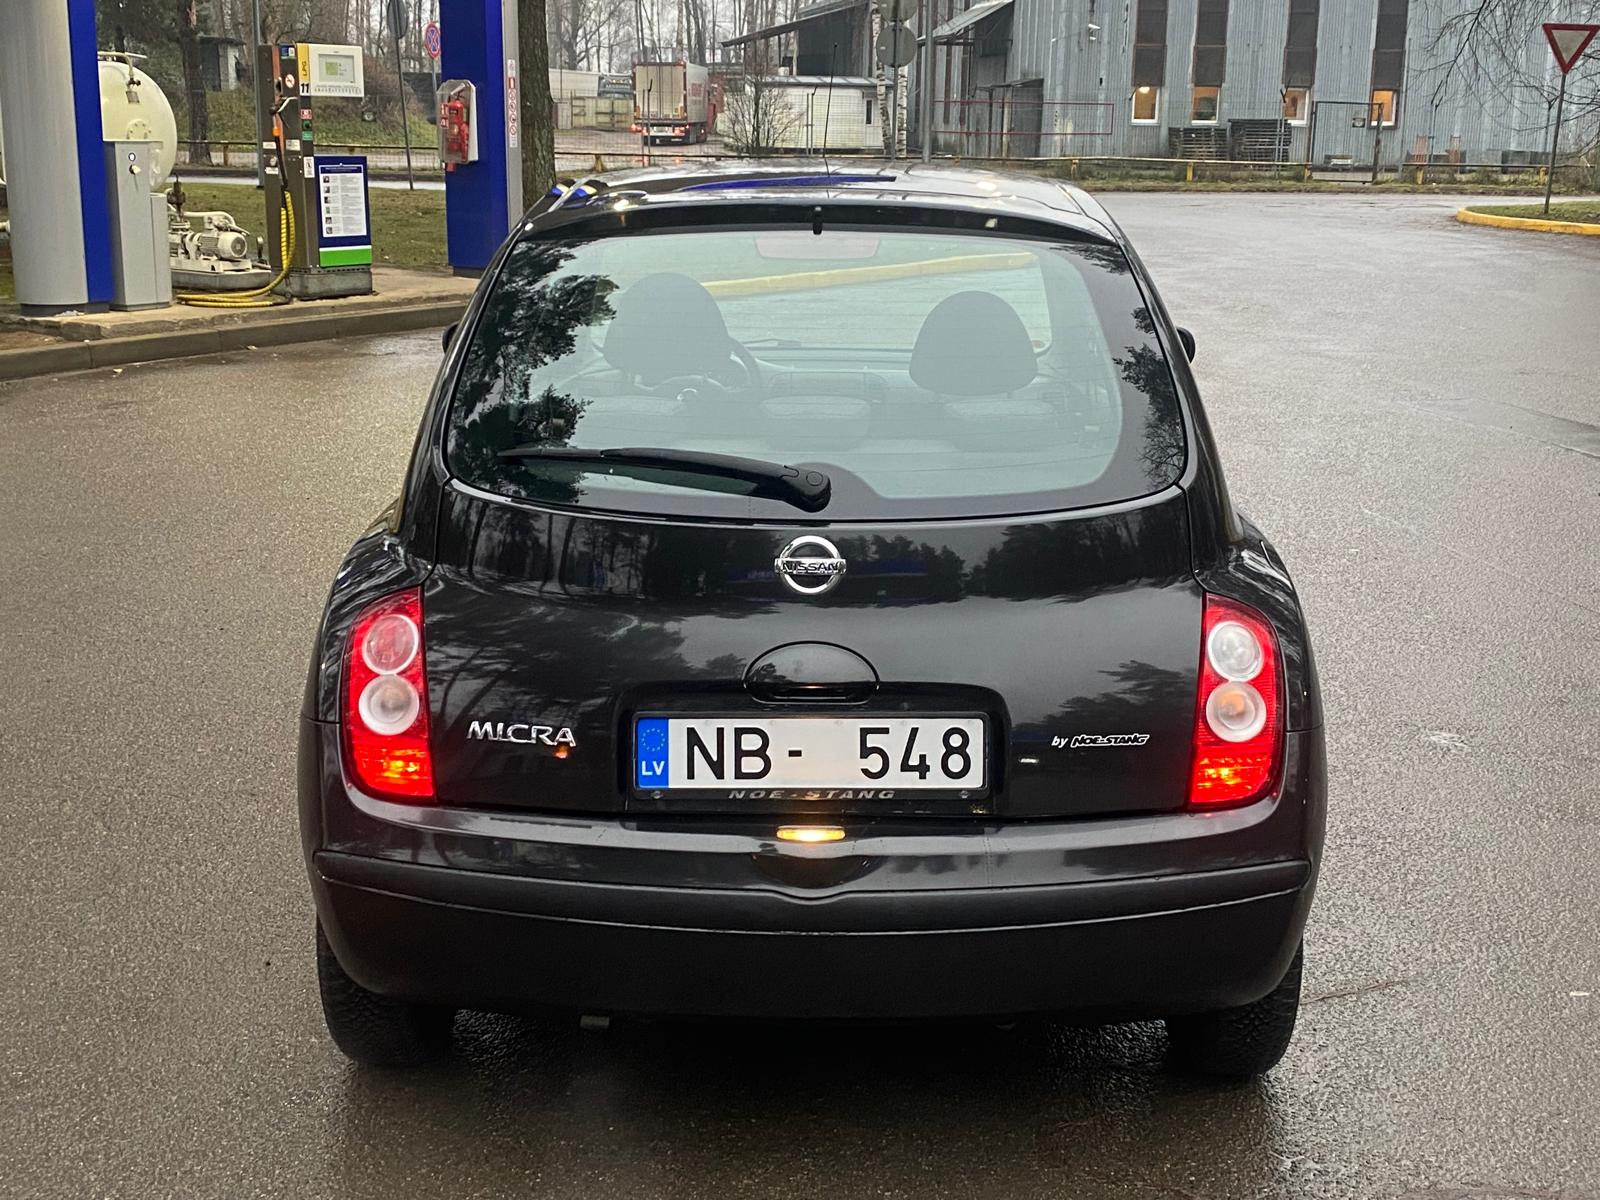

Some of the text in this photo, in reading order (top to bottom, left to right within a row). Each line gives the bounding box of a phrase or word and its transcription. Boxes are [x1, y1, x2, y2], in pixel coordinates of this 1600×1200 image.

[300, 82, 309, 94] 11
[782, 561, 838, 572] NISSAN
[466, 720, 577, 747] MICRA
[1051, 735, 1068, 749] by
[641, 761, 665, 776] LV
